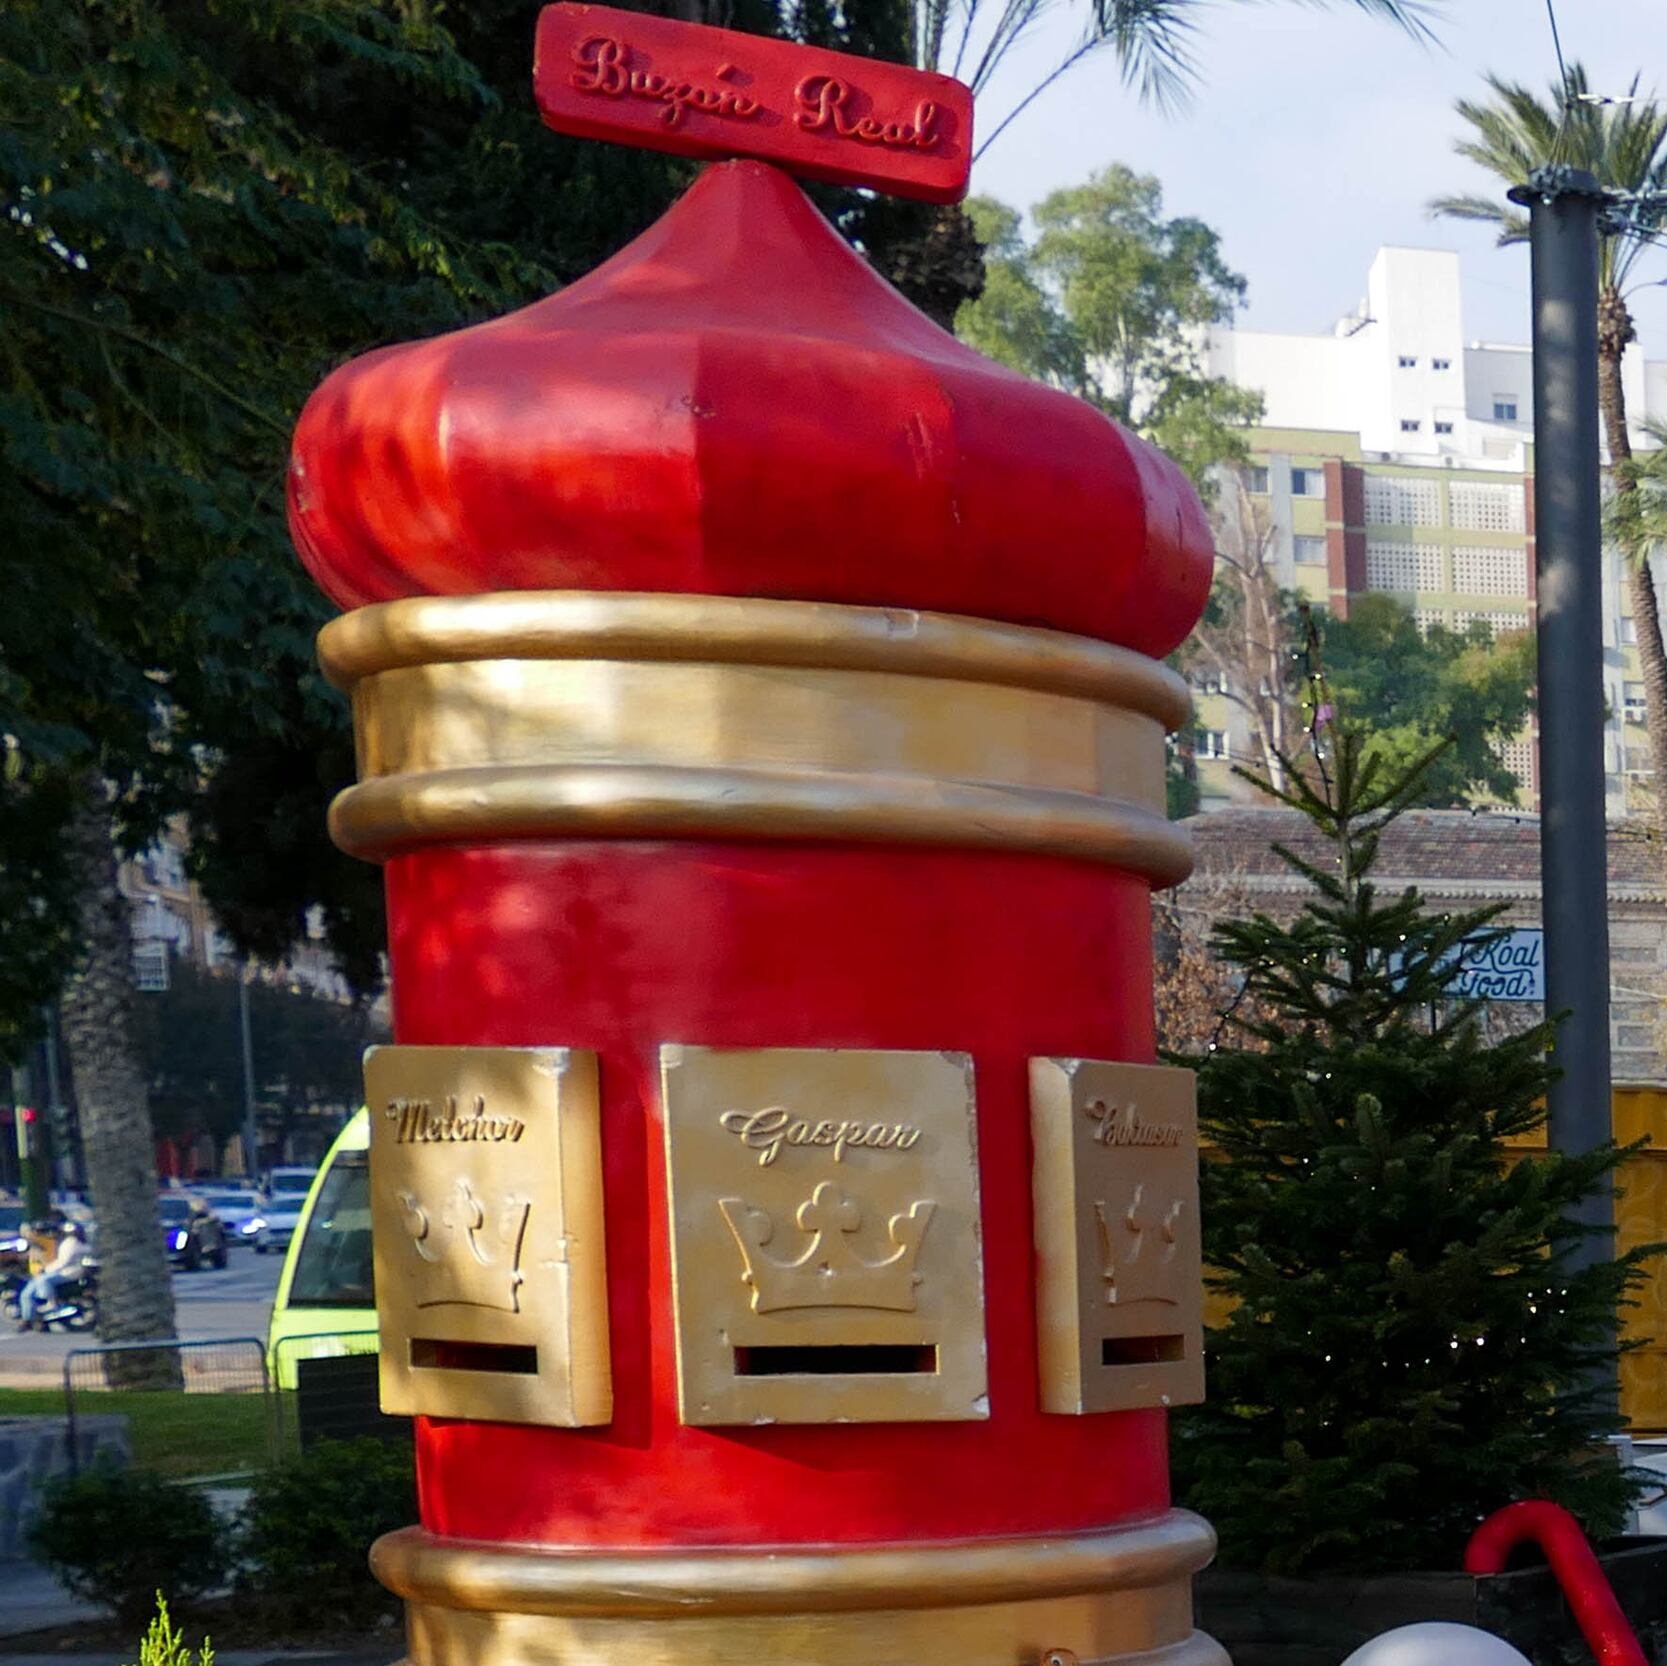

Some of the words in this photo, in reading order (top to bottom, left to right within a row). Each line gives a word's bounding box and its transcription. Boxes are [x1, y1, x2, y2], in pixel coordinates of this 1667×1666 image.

[572, 35, 759, 126] Buzón
[794, 75, 939, 148] Real
[386, 1094, 525, 1145] Melchor
[720, 1106, 922, 1165] Gaspar
